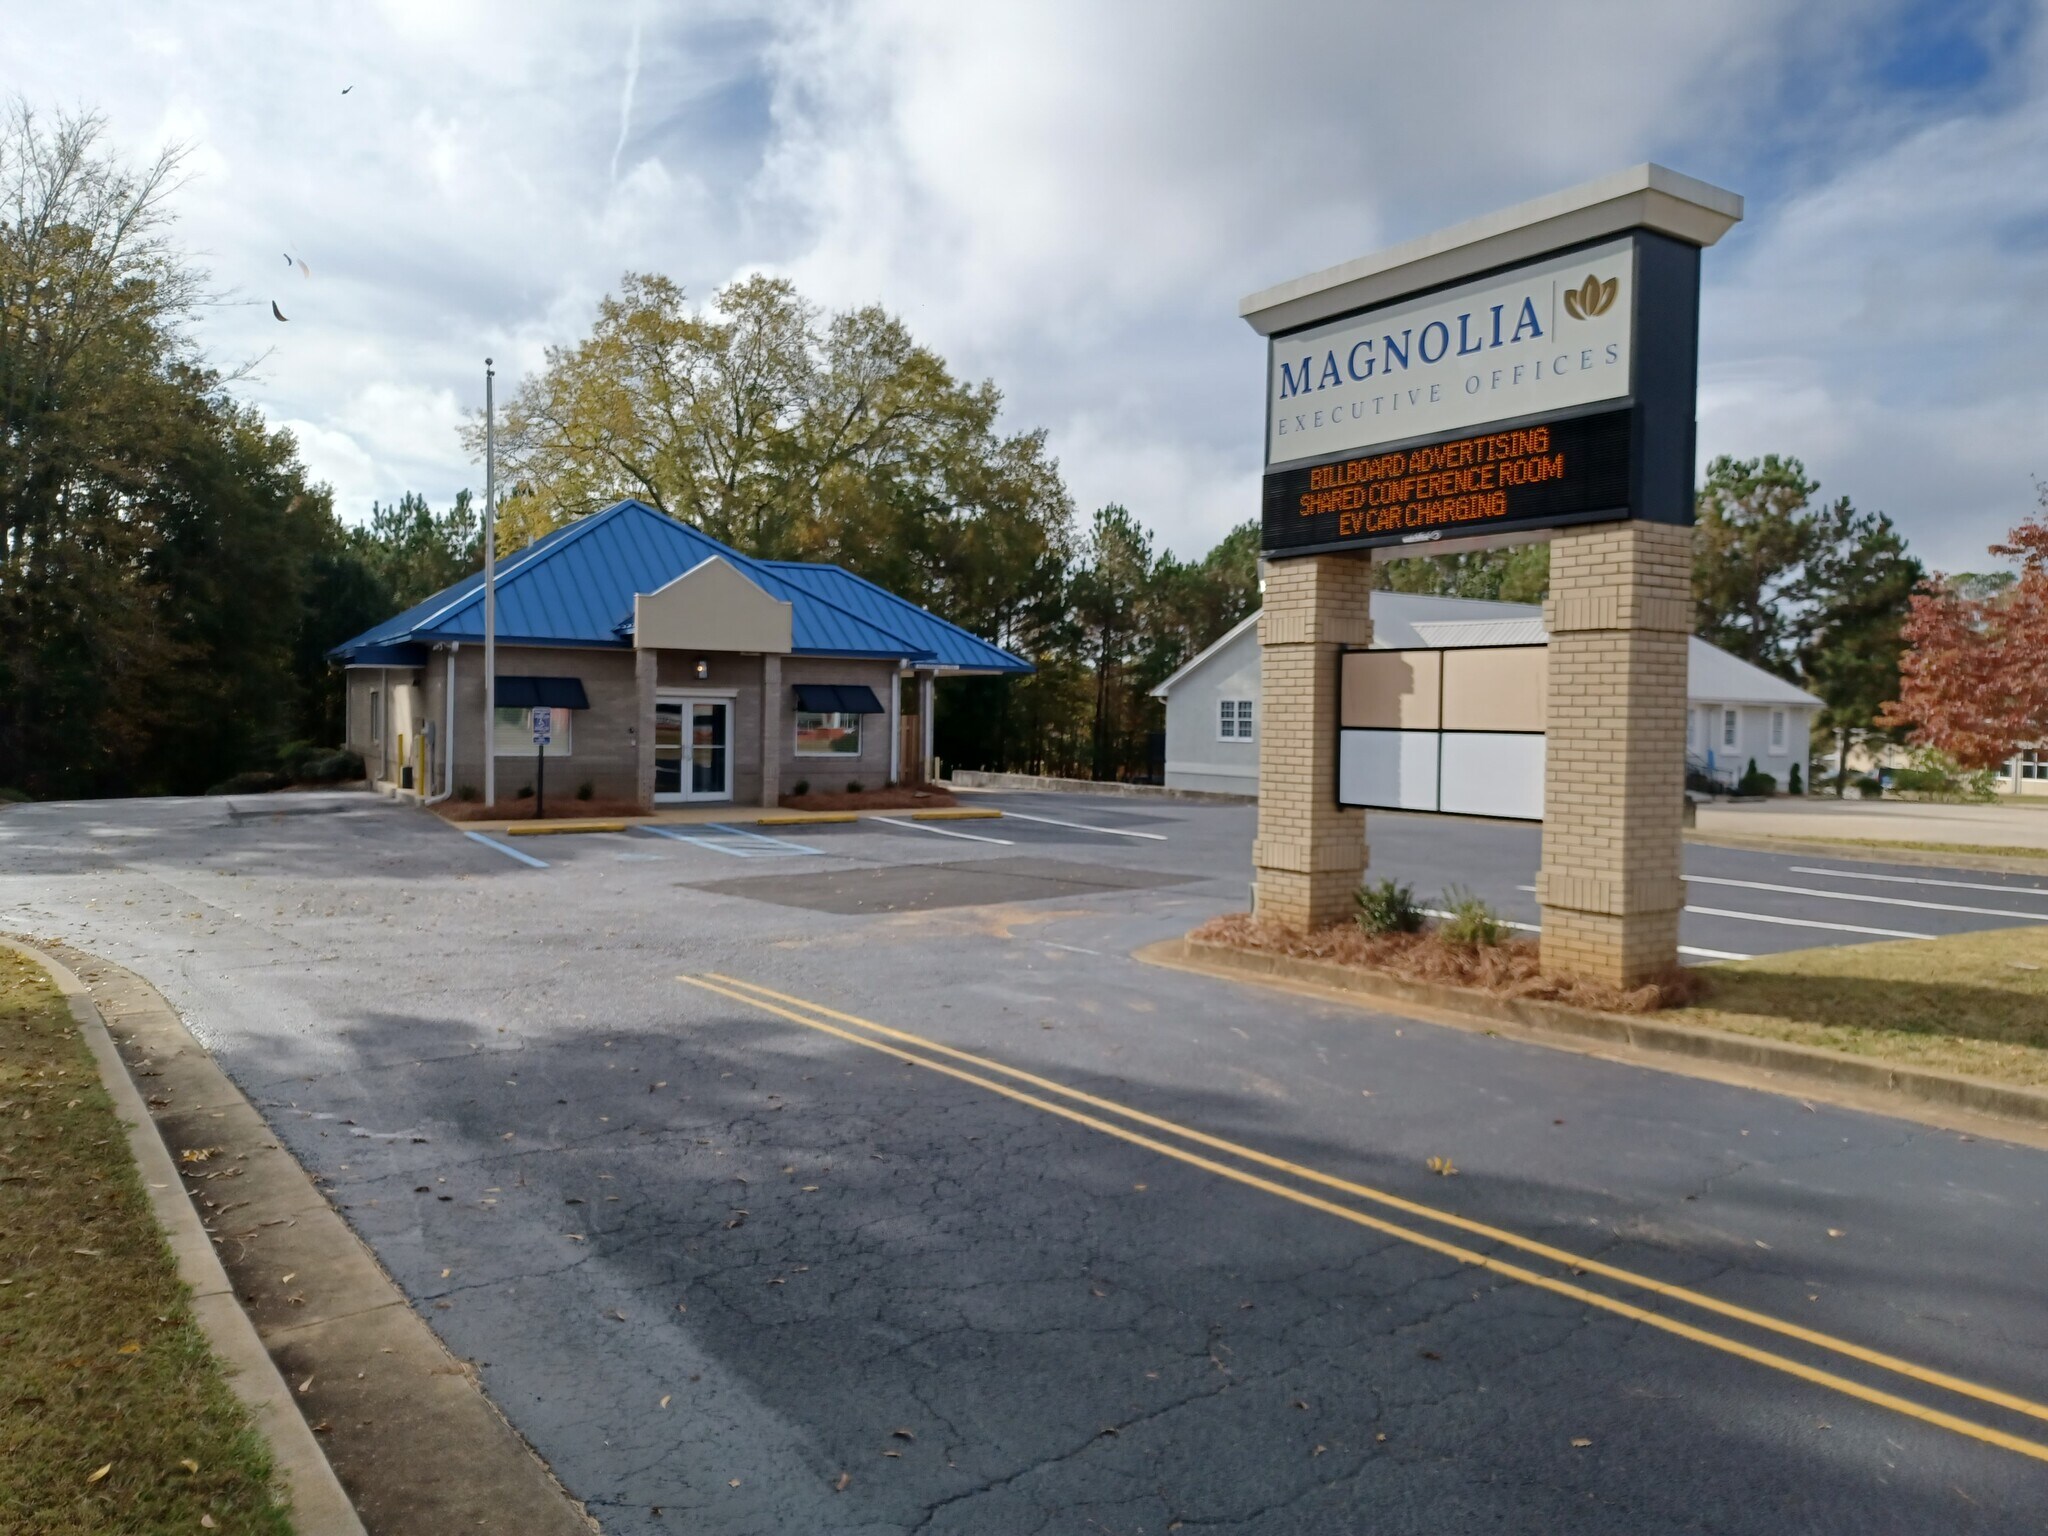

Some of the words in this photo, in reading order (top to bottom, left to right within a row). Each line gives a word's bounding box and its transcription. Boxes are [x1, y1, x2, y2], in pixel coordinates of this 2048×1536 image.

[1279, 296, 1543, 400] MAGNOLIA
[1278, 383, 1441, 436] EXECUTIVE
[1465, 342, 1619, 395] OFFICES
[1300, 485, 1367, 516] SHARED
[1368, 466, 1497, 506] CONFERENCE
[1500, 452, 1565, 487] ROOM
[1310, 453, 1404, 491] BILLBOARD
[1408, 426, 1550, 474] ADVERTISING
[1339, 511, 1363, 536] EV
[1366, 506, 1404, 533] CAR
[1405, 491, 1508, 528] CHARGING
